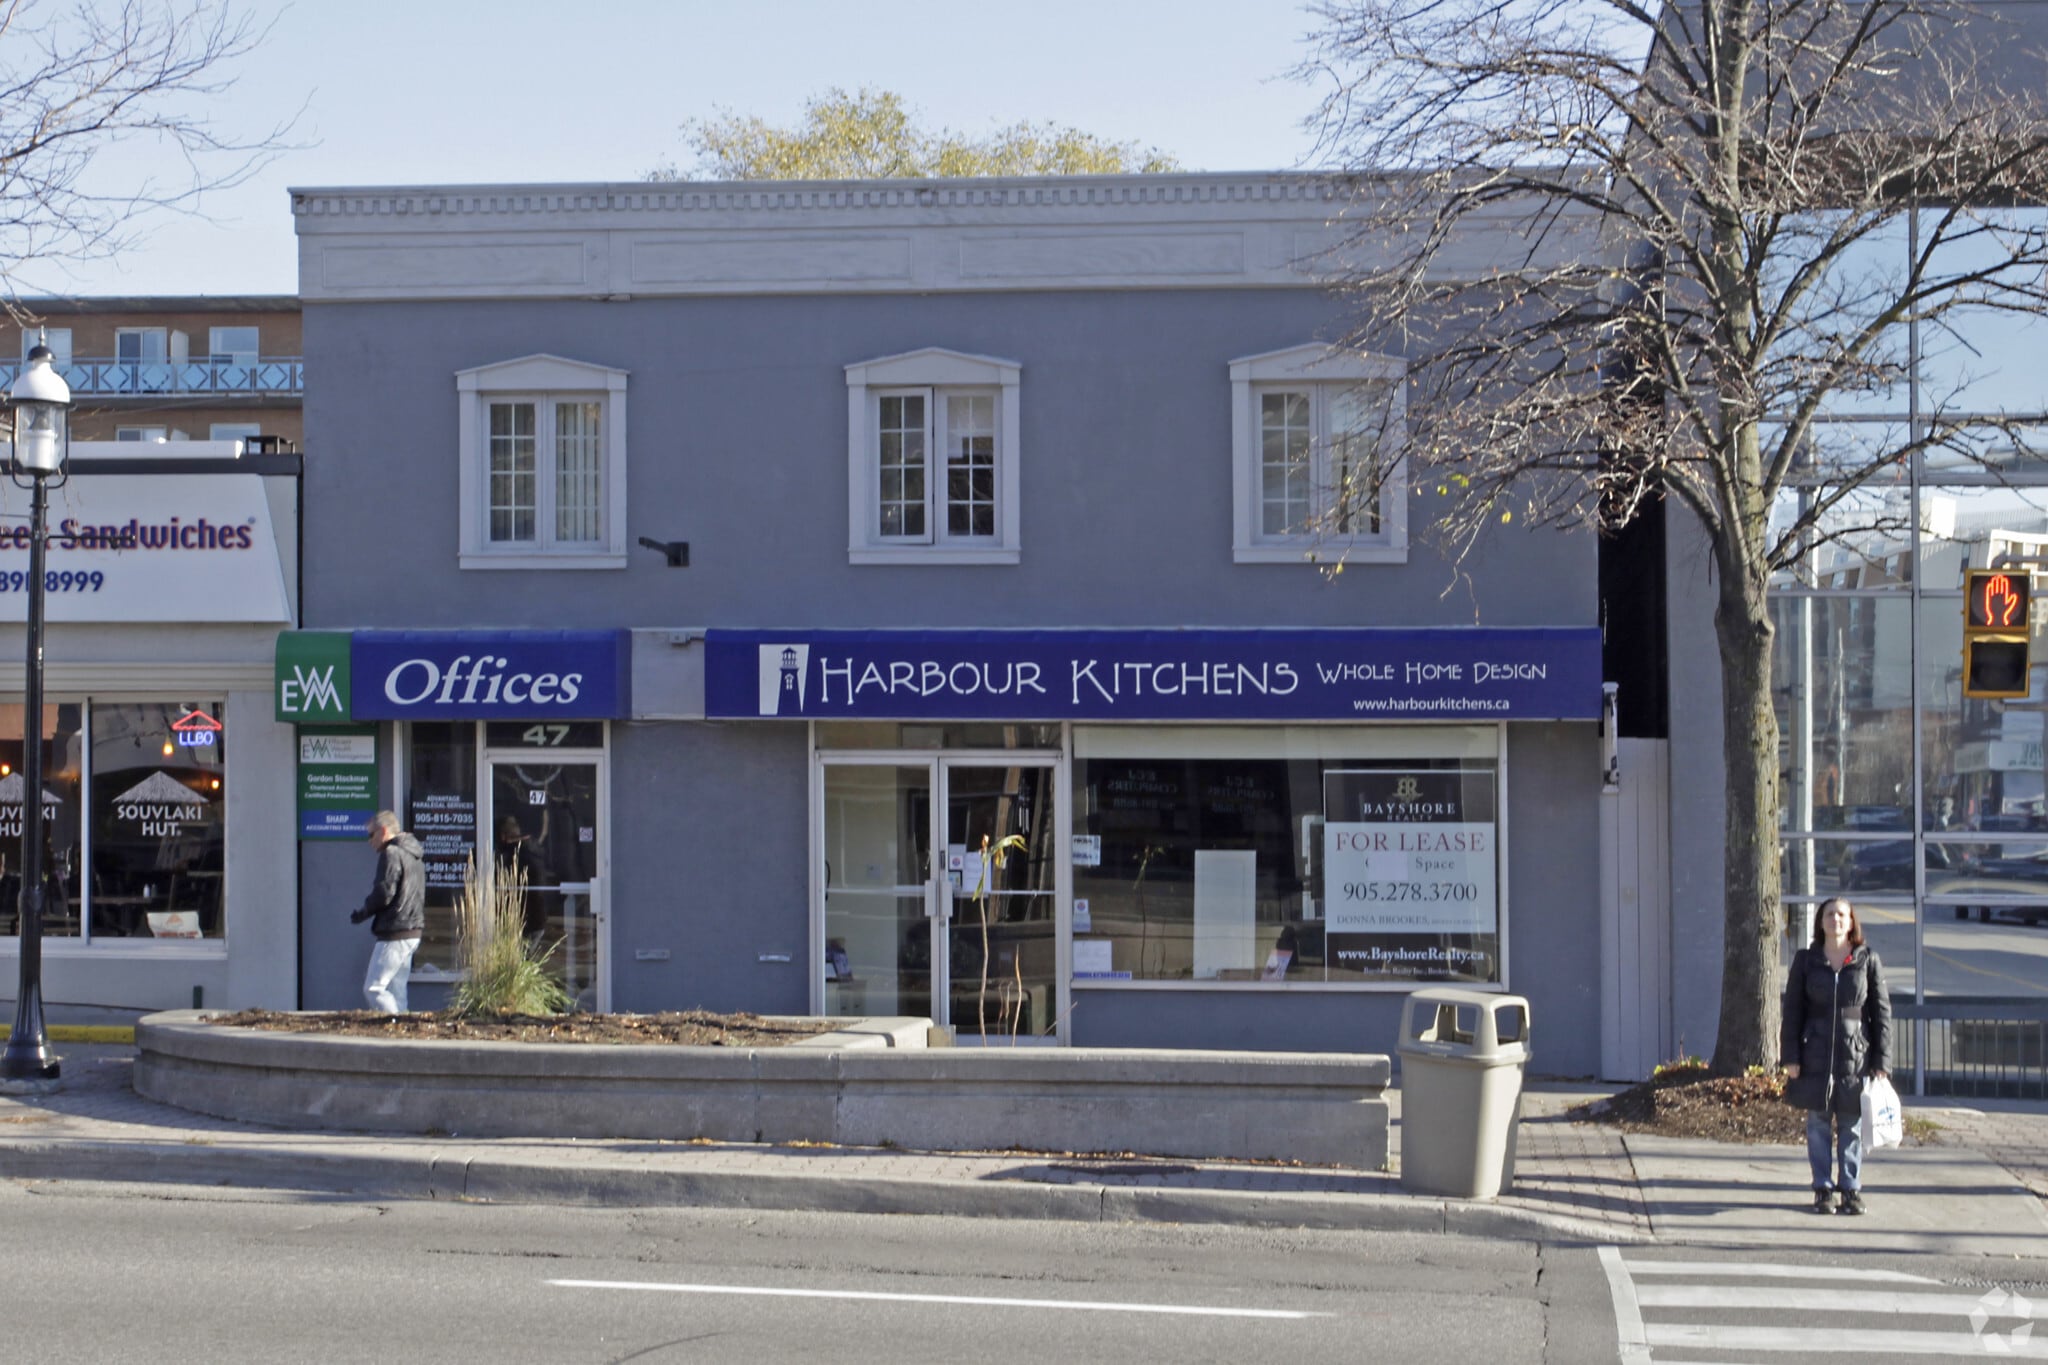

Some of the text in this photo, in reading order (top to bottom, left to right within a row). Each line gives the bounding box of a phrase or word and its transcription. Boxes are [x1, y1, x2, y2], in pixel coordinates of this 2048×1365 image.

[60, 516, 252, 550] Sandwiches
[0, 570, 104, 592] 8918999
[384, 655, 582, 705] Offices
[820, 657, 1546, 705] HARBOUR KITCHENS WHOLE HOME DESIGN
[1353, 697, 1510, 711] www.harbourkitchens.ca
[179, 730, 213, 746] LLBO
[523, 725, 570, 745] 47
[117, 804, 202, 820] SOUVLAKI
[1363, 803, 1456, 815] BAYSHORE
[1336, 832, 1485, 852] FOR LEASE
[1415, 857, 1455, 872] Space
[1343, 882, 1477, 901] 905.278.3700
[1336, 915, 1376, 925] DONNA
[1338, 946, 1485, 963] www.BayshoreRealty.ca
